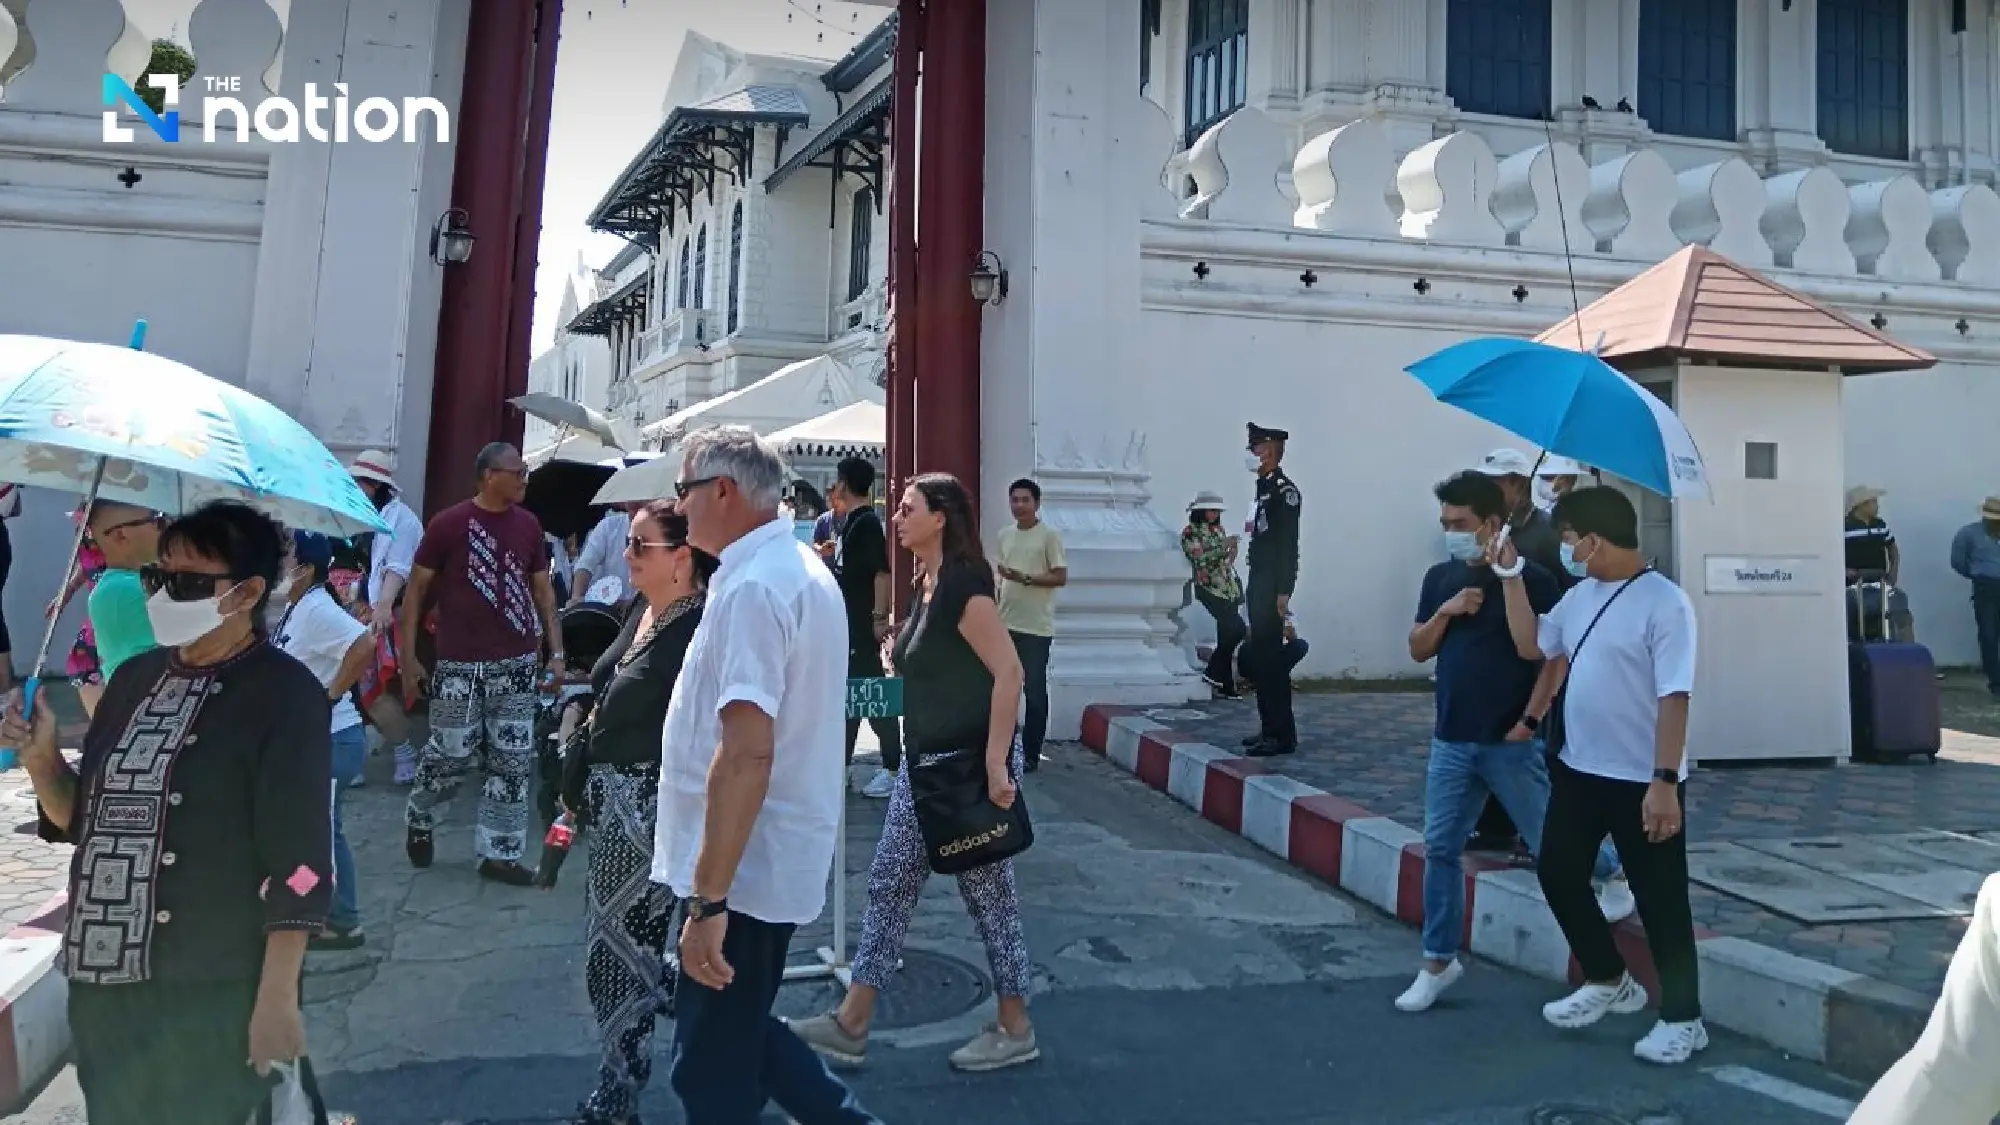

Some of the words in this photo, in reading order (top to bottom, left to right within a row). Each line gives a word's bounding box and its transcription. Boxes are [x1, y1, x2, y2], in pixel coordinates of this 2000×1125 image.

[845, 678, 883, 702] เข้า
[845, 700, 889, 718] NTRY
[939, 832, 991, 857] adidas
